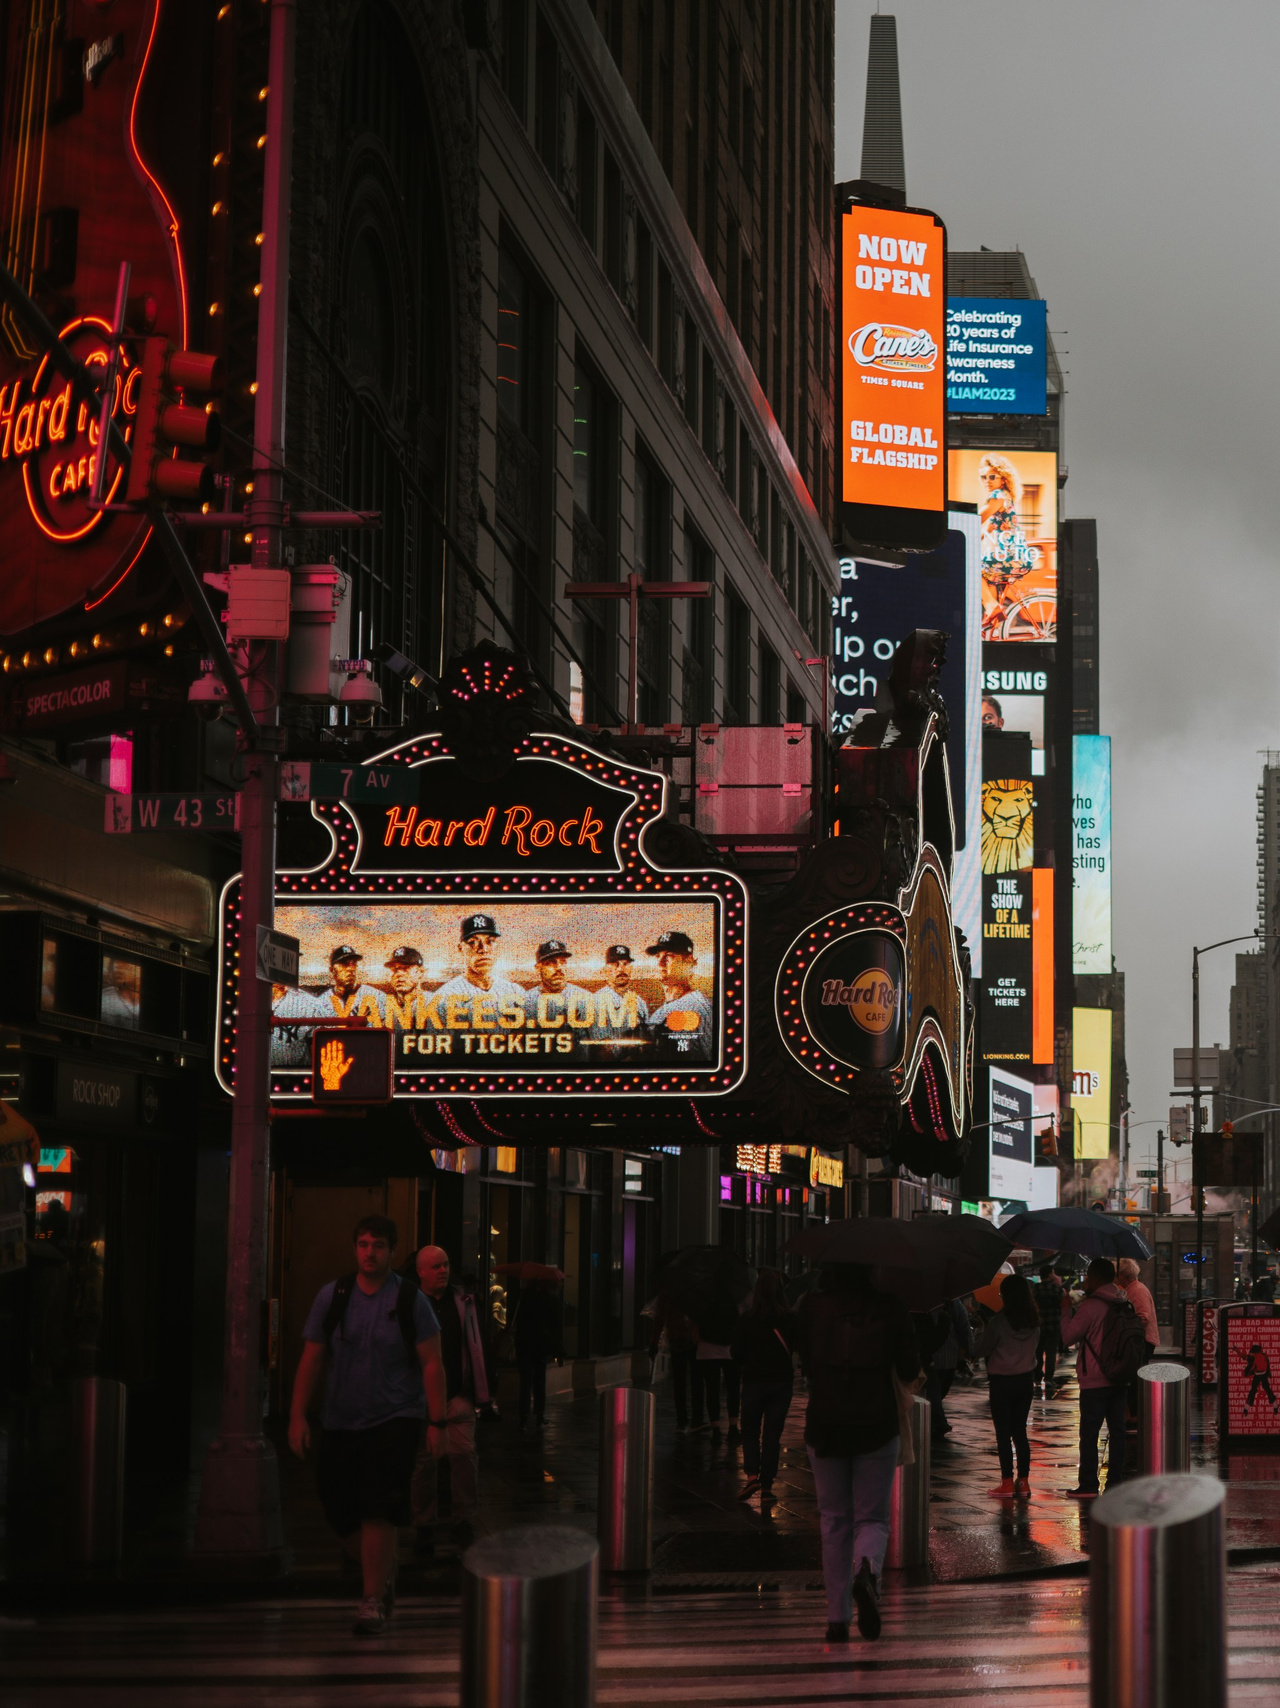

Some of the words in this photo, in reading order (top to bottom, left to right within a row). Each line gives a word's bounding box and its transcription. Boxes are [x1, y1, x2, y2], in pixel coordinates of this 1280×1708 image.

[858, 234, 927, 266] NOW
[855, 264, 931, 297] OPEN
[947, 309, 1021, 327] Celebrating
[854, 322, 937, 363] Cane's
[962, 326, 999, 339] years
[1001, 326, 1016, 338] of
[969, 341, 1033, 355] Insurance
[861, 375, 889, 386] TIMES
[891, 379, 925, 390] SQUARE
[850, 419, 938, 449] GLOBAL
[850, 446, 938, 471] FLAGSHIP
[338, 659, 365, 671] NYPD
[832, 668, 878, 697] ch
[981, 671, 1048, 691] SUNG
[26, 679, 111, 717] SPECTACOLOR
[340, 769, 354, 797] 7
[366, 771, 391, 789] Av
[1072, 793, 1092, 809] ho
[138, 799, 160, 828] W
[173, 798, 202, 828] 43
[215, 798, 235, 816] St
[383, 805, 497, 848] Hard
[501, 804, 605, 857] Rock
[1077, 833, 1101, 849] has
[996, 879, 1017, 894] THE
[991, 894, 1023, 909] SHOW
[995, 909, 1009, 923] OF
[1011, 909, 1019, 923] A
[983, 923, 1031, 939] LIFETIME
[263, 943, 276, 966] ONE
[281, 949, 296, 975] WAY
[987, 988, 1027, 997] TICKETS
[997, 977, 1017, 987] GET
[821, 979, 877, 1006] Hard
[878, 982, 901, 1012] Roc
[995, 998, 1020, 1007] HERE
[330, 991, 640, 1031] YANKEES.COM
[865, 1012, 886, 1022] CAFE
[402, 1033, 452, 1055] FOR
[460, 1033, 574, 1055] TICKETS
[72, 1079, 97, 1105] ROCK
[97, 1083, 121, 1108] SHOP
[1203, 1308, 1216, 1384] CHICAGO
